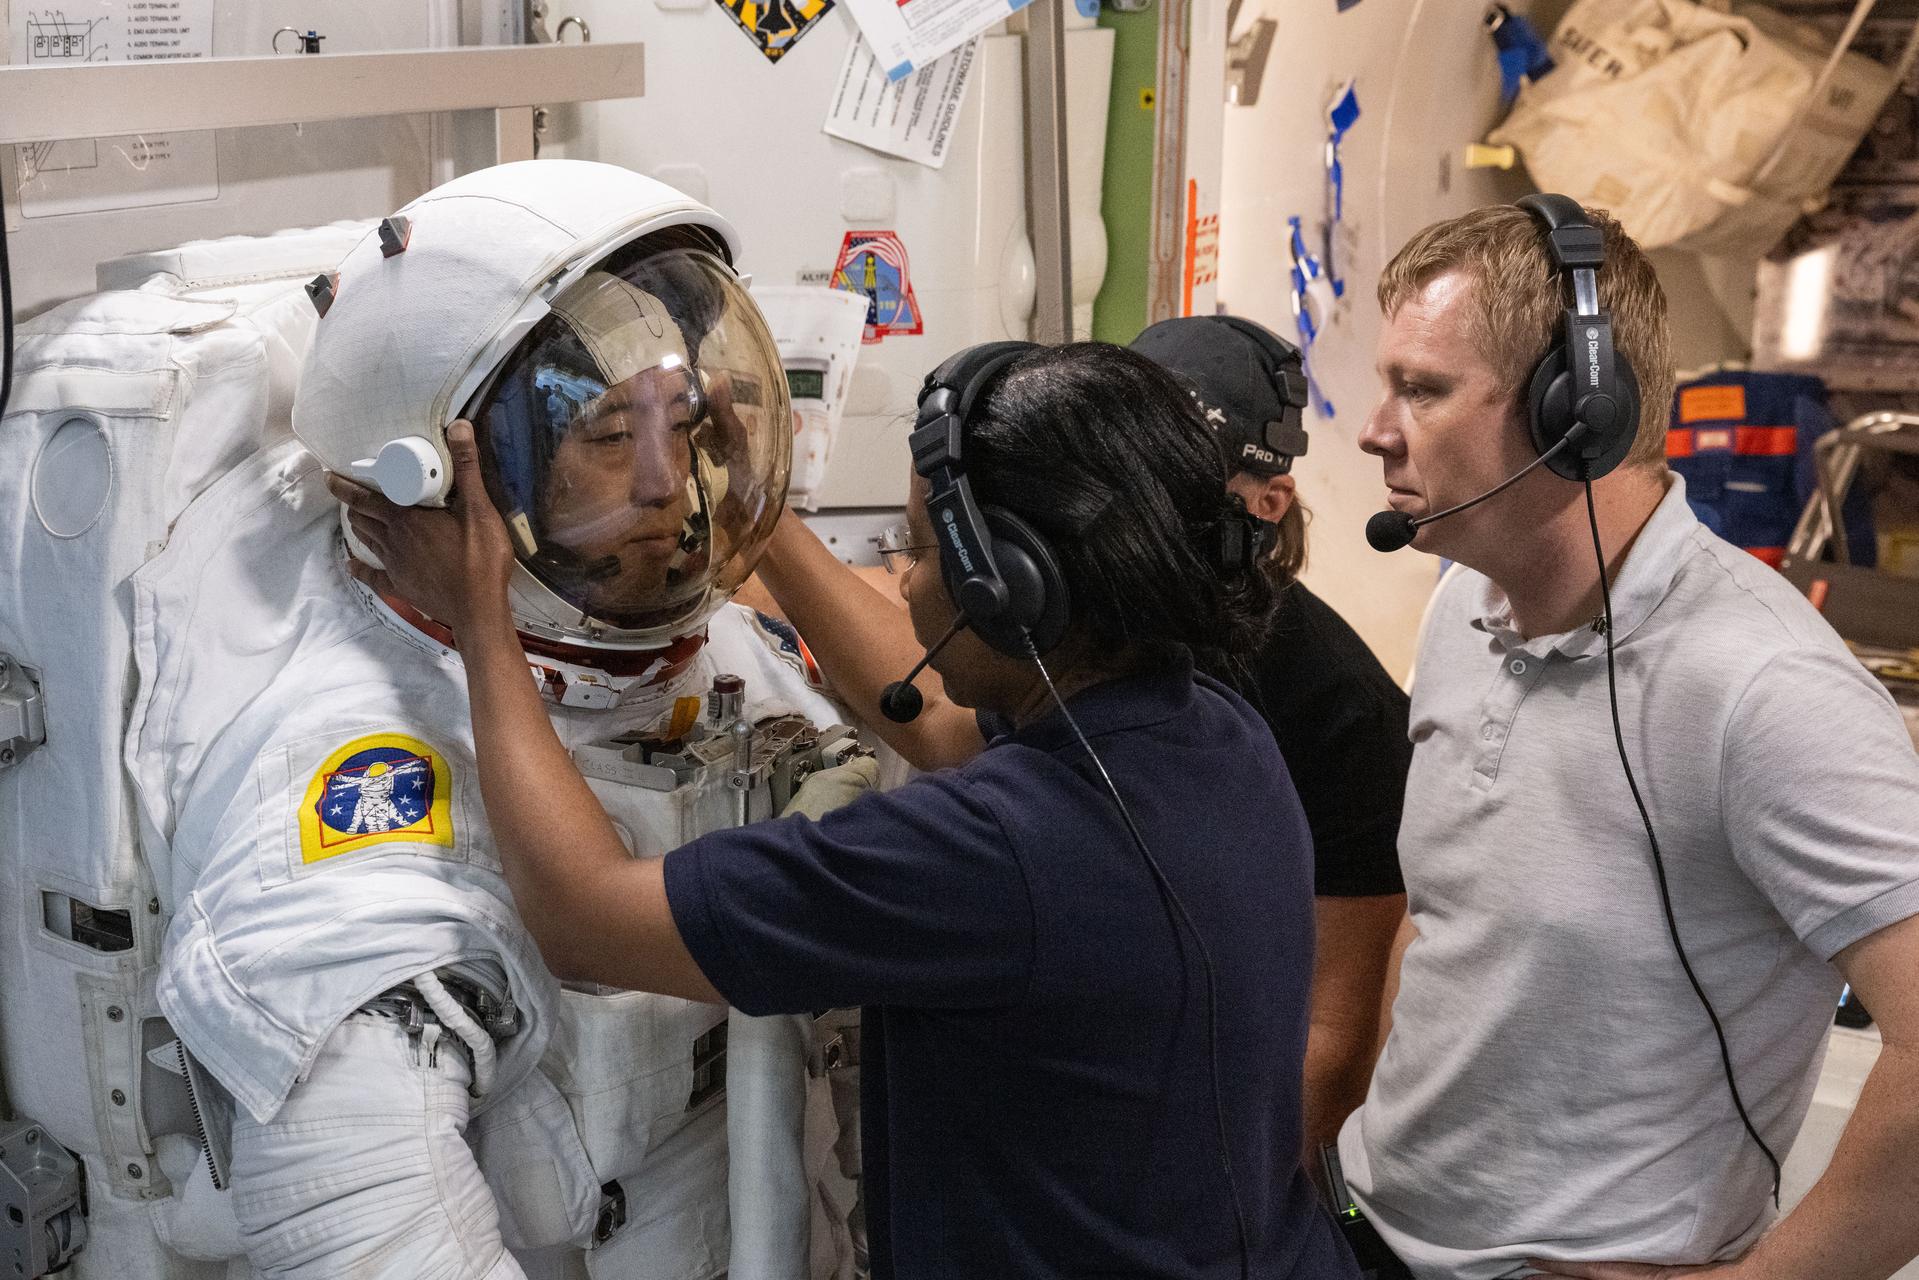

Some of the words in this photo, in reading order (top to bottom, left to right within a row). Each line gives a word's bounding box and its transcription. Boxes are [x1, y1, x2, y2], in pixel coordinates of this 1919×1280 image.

[951, 49, 974, 102] STOWAGE
[1588, 340, 1600, 387] Clear-Com
[947, 522, 974, 573] Clear-Com
